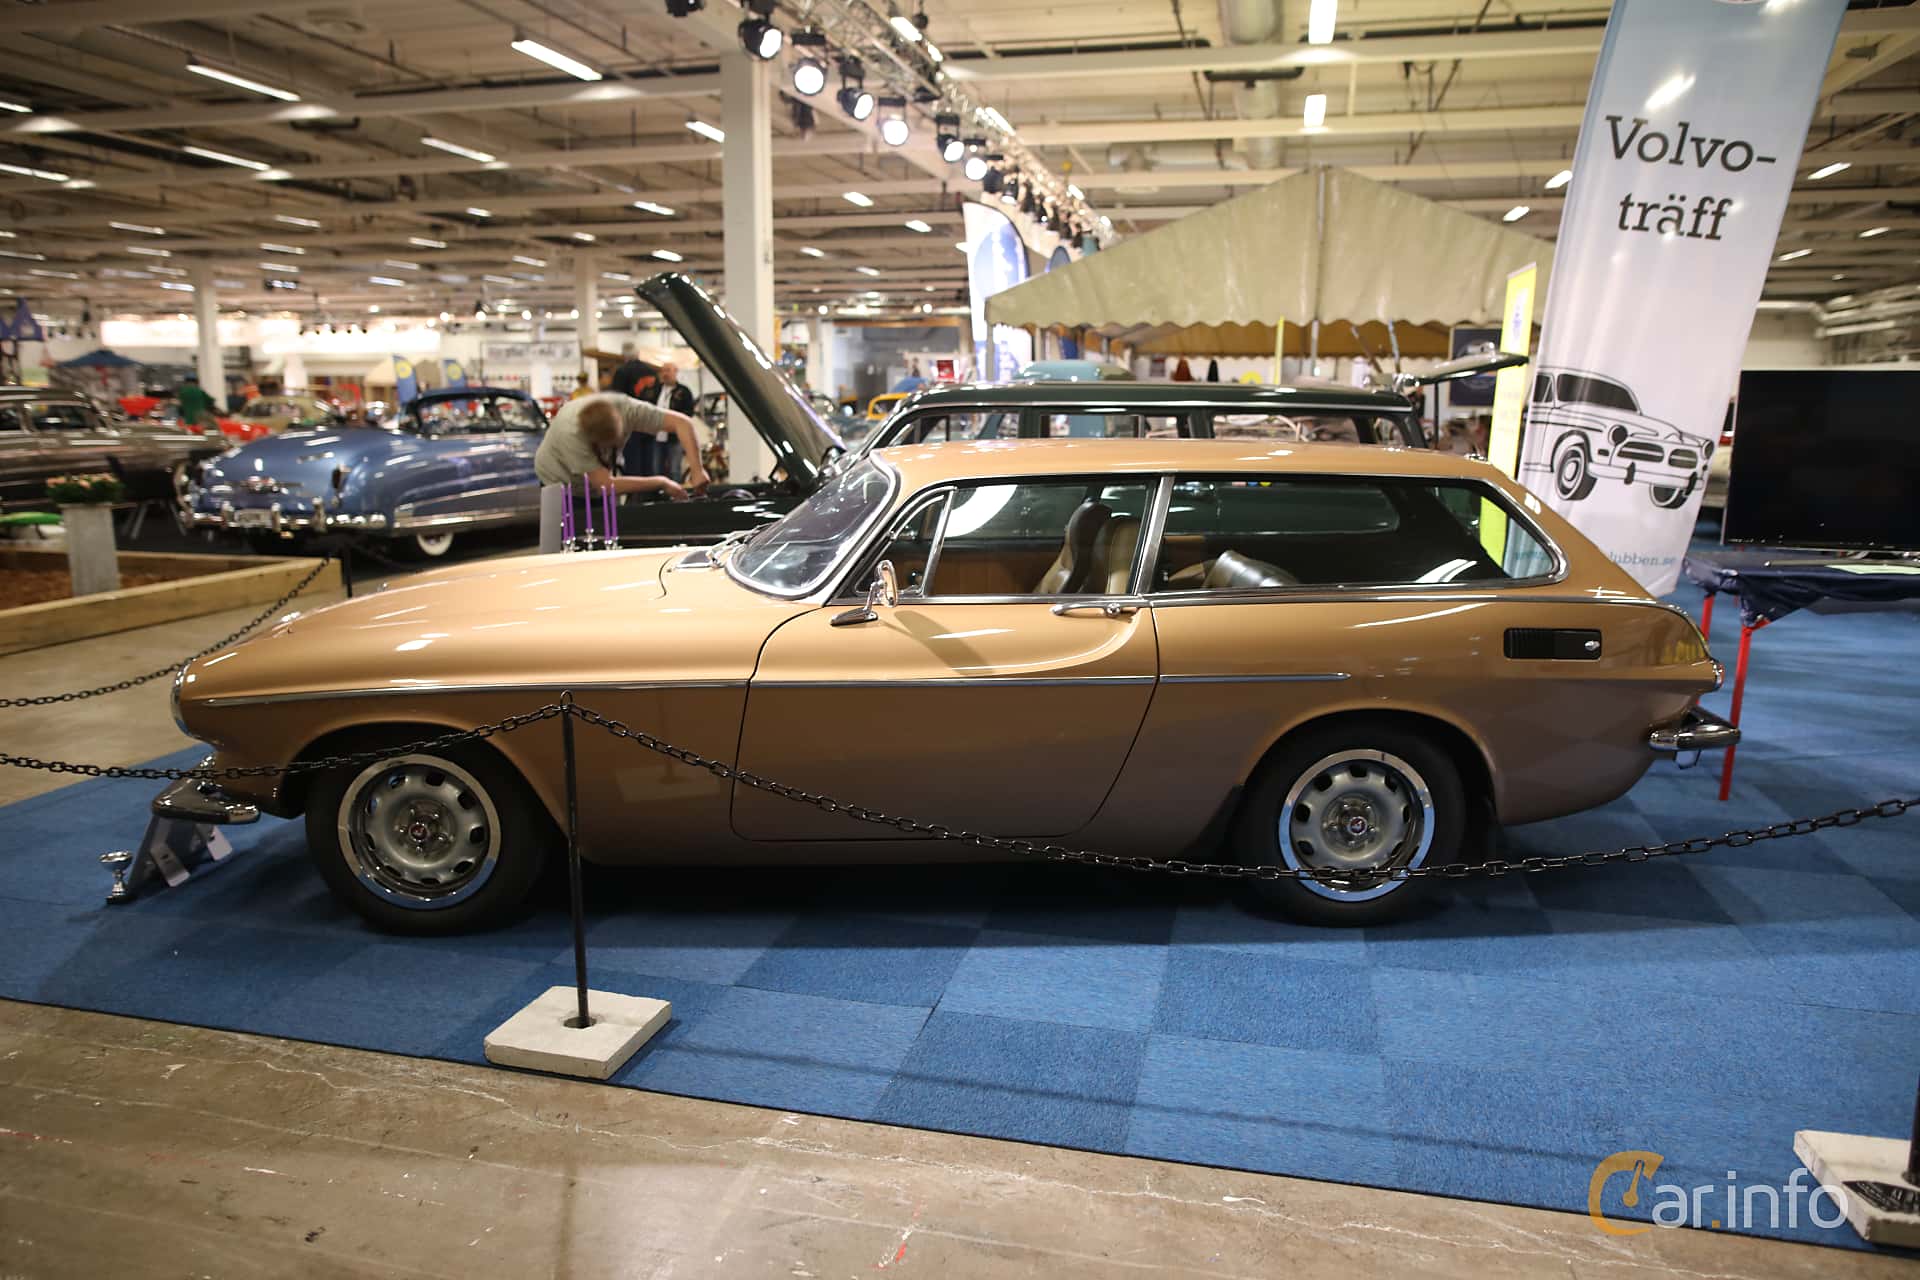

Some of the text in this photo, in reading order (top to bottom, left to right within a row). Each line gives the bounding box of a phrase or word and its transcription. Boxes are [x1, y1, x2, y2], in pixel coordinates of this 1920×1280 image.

[1605, 115, 1776, 172] Volvo-
[1618, 192, 1733, 240] träff
[1609, 551, 1678, 567] lubben.se
